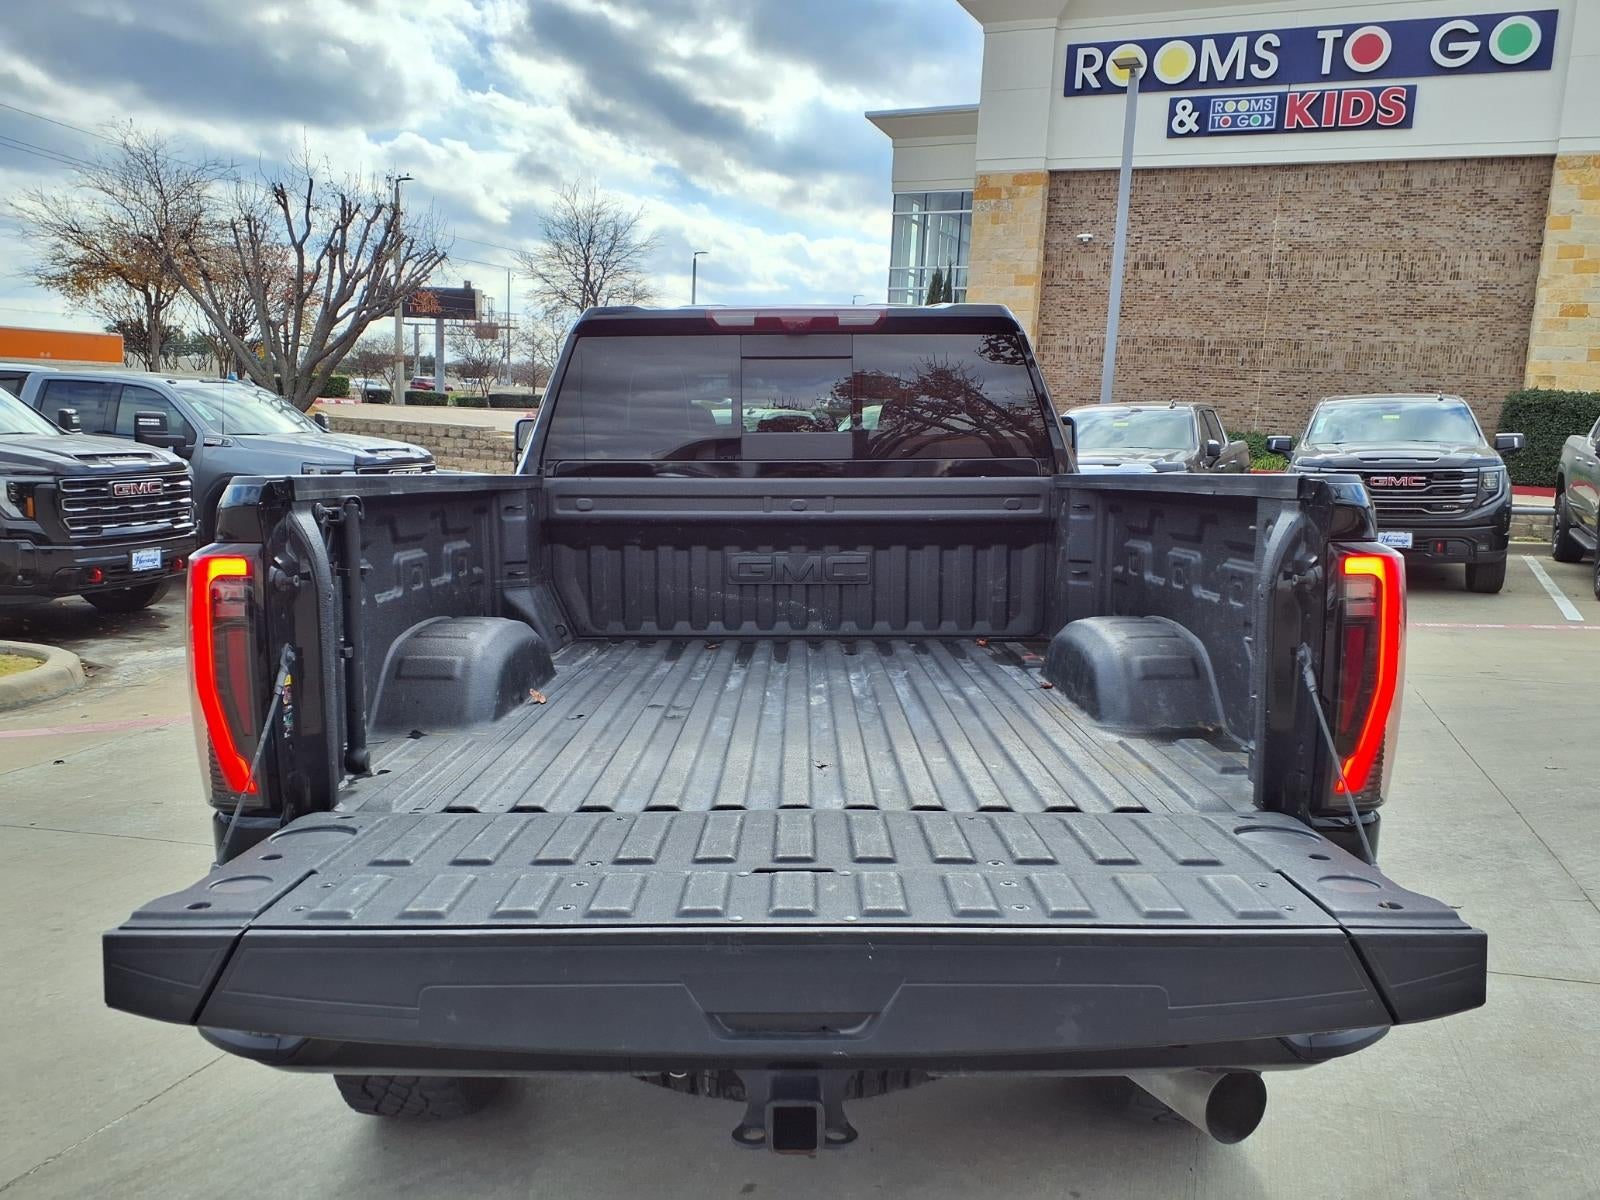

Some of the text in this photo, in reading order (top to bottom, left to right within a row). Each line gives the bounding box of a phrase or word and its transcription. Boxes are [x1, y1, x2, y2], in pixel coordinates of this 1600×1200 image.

[1074, 15, 1542, 90] ROOMS TO GO
[1171, 86, 1407, 134] & KIDS
[1214, 98, 1272, 113] ROOMS
[1213, 113, 1261, 128] TO GO
[113, 481, 162, 496] GMC
[1370, 476, 1426, 486] GMC
[730, 554, 869, 583] GMC
